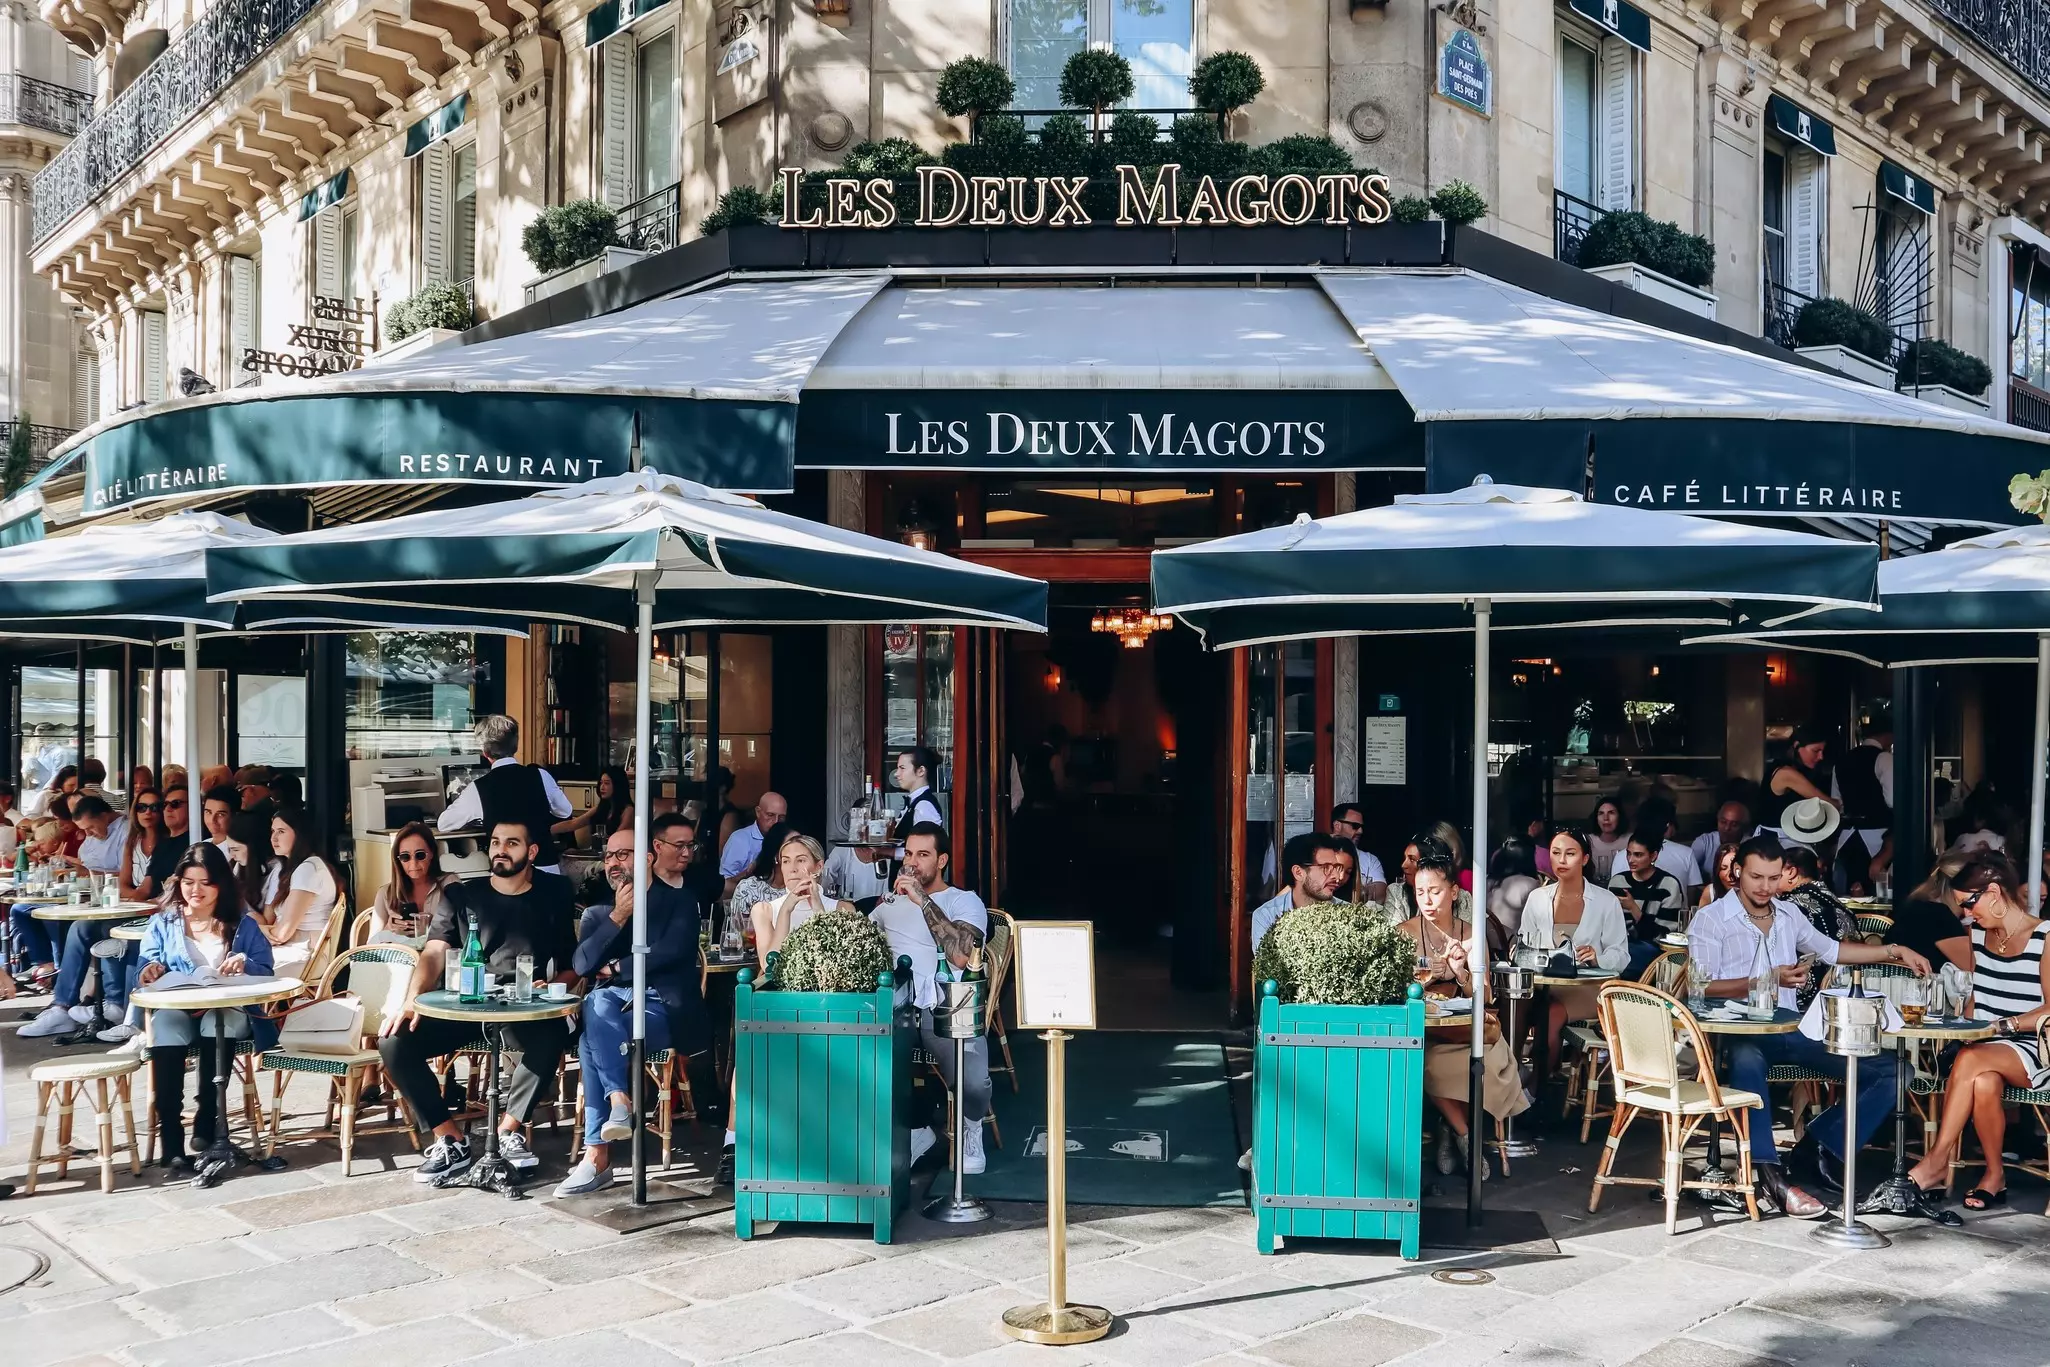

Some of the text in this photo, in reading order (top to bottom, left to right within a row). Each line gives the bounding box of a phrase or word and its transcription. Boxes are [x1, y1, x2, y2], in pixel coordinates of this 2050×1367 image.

[1449, 66, 1483, 90] SAINT-GERMAIN
[1458, 58, 1474, 73] PLACE
[1453, 81, 1464, 94] DES
[778, 163, 1392, 228] LES DEUX MAGOTS
[884, 412, 1326, 457] LES DEUX MAGOTS
[399, 453, 604, 478] RESTAURANT
[1614, 479, 1903, 509] CAFÉ LITTÉRAIRE
